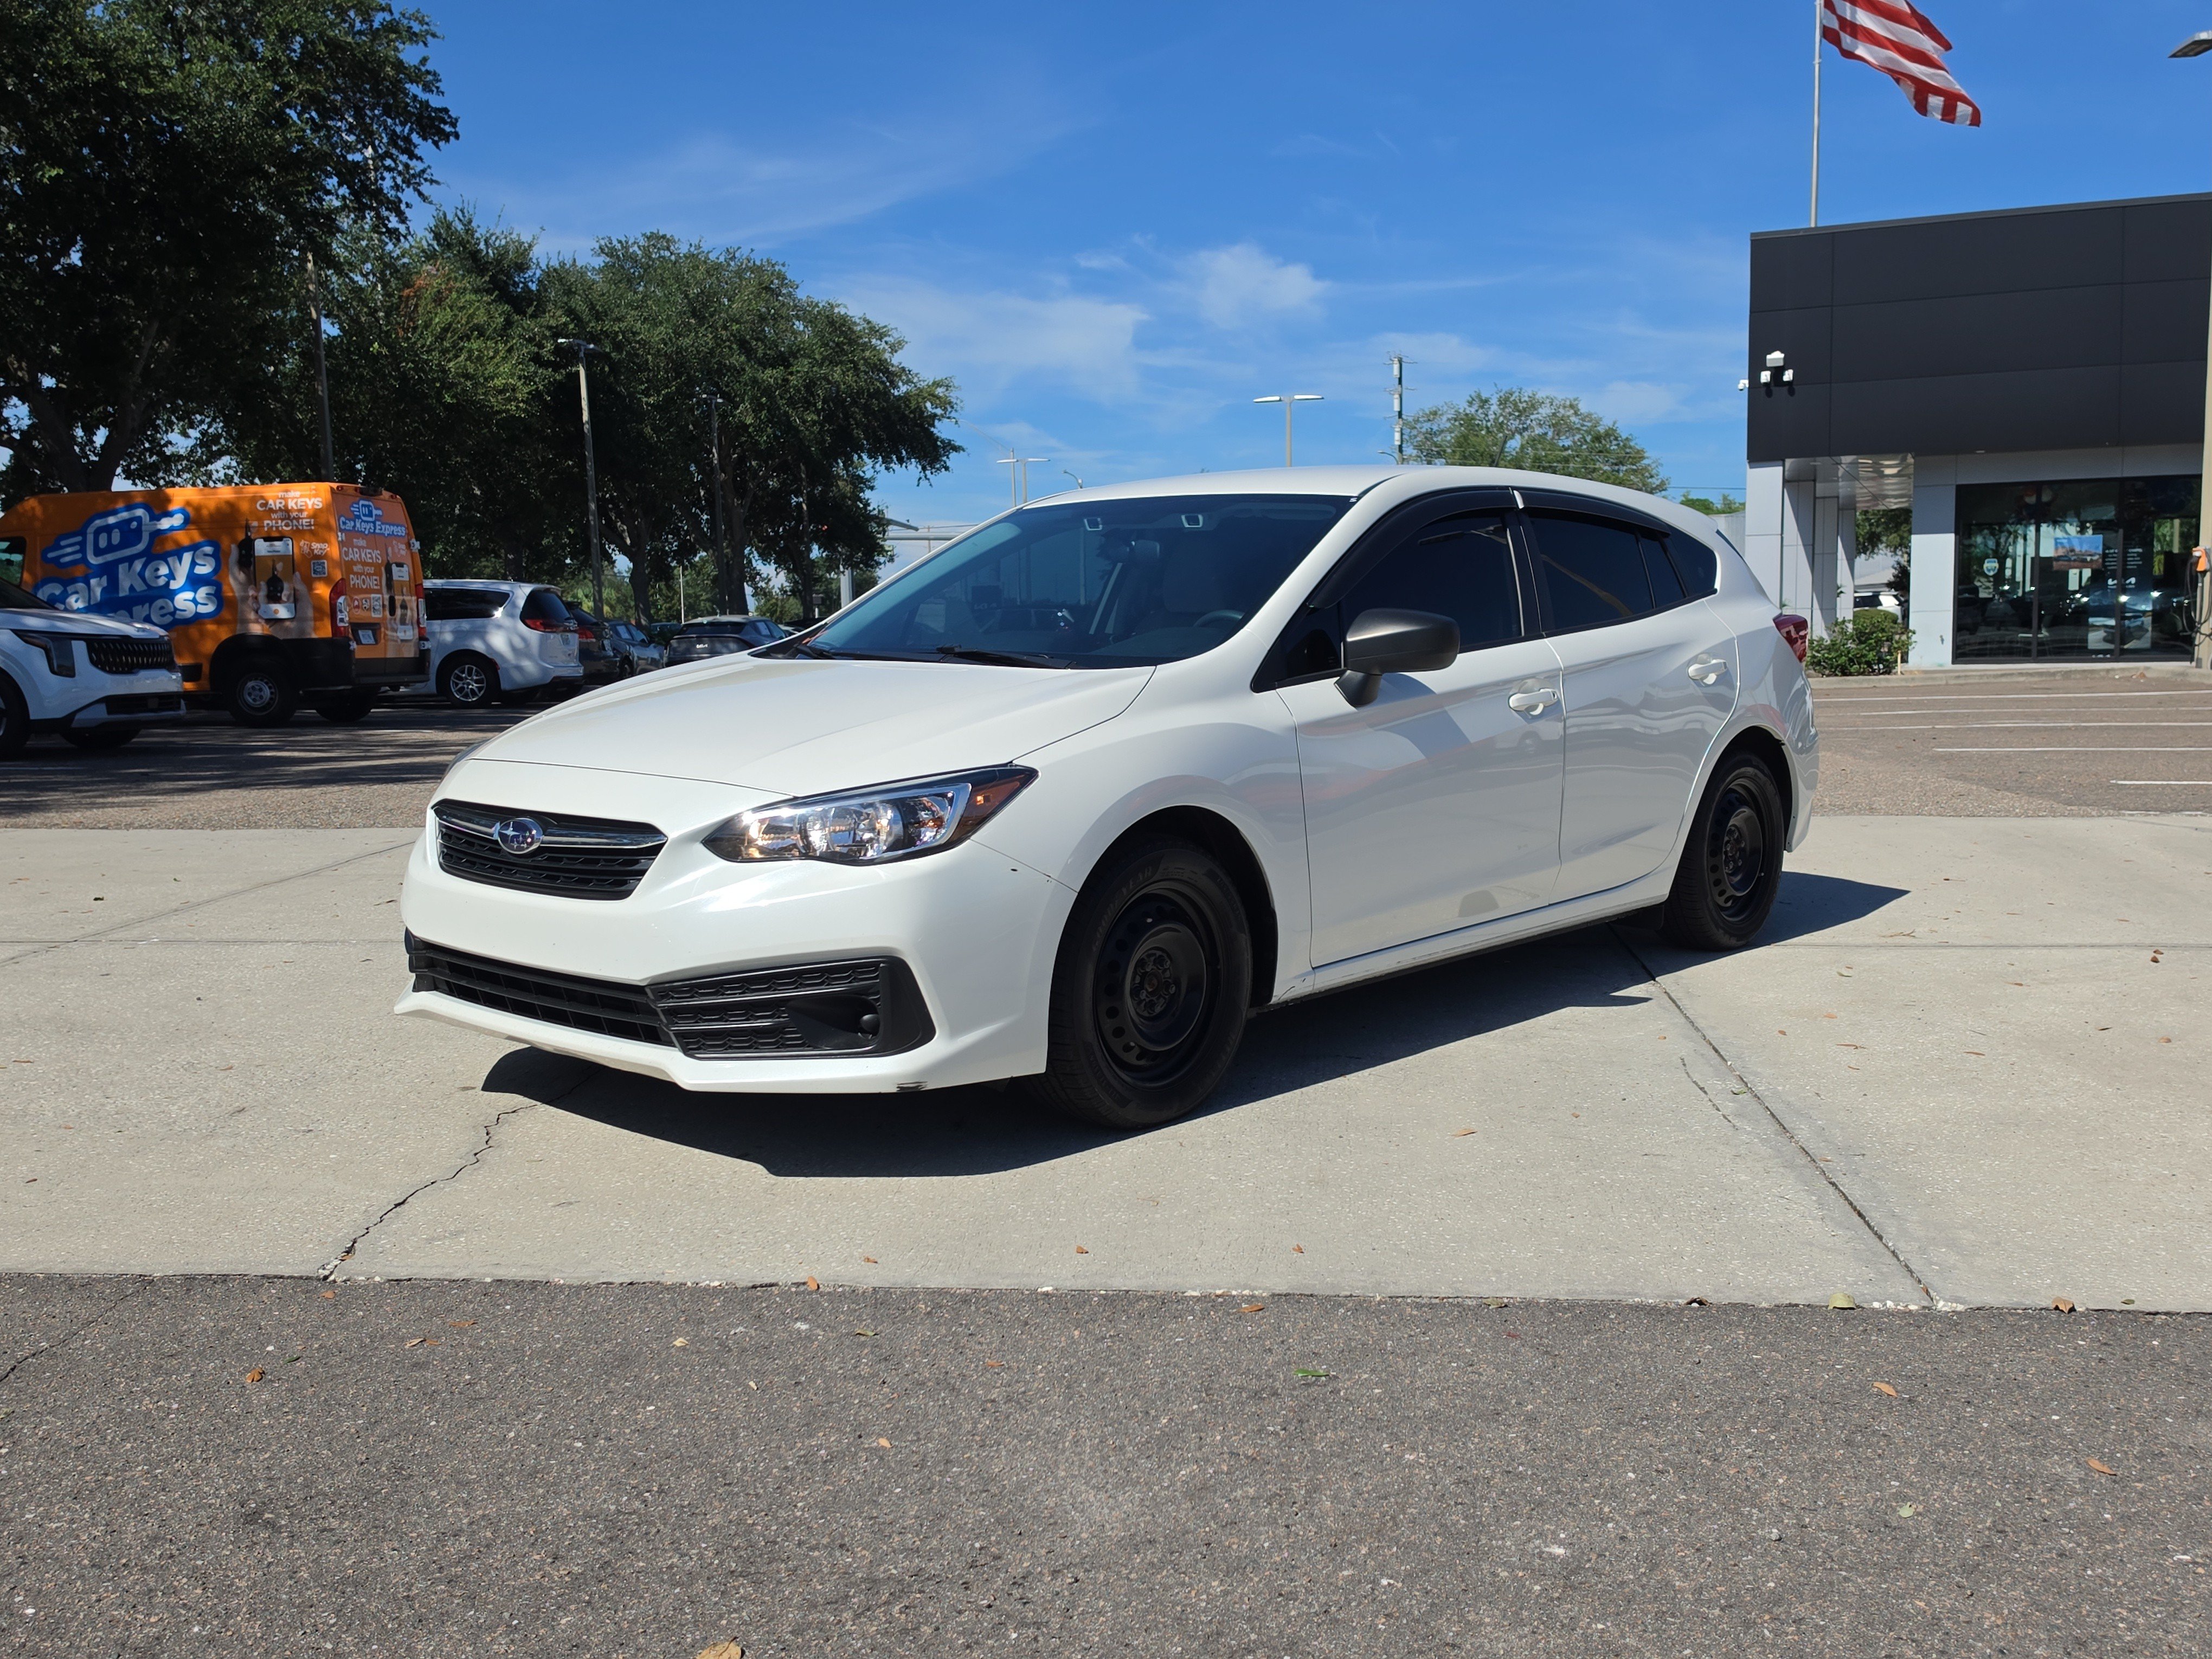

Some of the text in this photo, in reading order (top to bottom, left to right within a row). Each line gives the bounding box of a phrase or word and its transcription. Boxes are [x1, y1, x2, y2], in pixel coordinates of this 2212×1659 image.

[256, 497, 323, 511] CAR KEYS
[290, 511, 308, 519] your
[263, 518, 314, 531] PHONE!
[339, 516, 406, 536] Car Keys Express
[342, 547, 360, 562] CAR
[361, 548, 382, 563] KEYS
[352, 564, 375, 575] with your
[36, 546, 216, 610] Car Keys
[350, 574, 380, 589] PHONE!
[113, 586, 217, 624] ress
